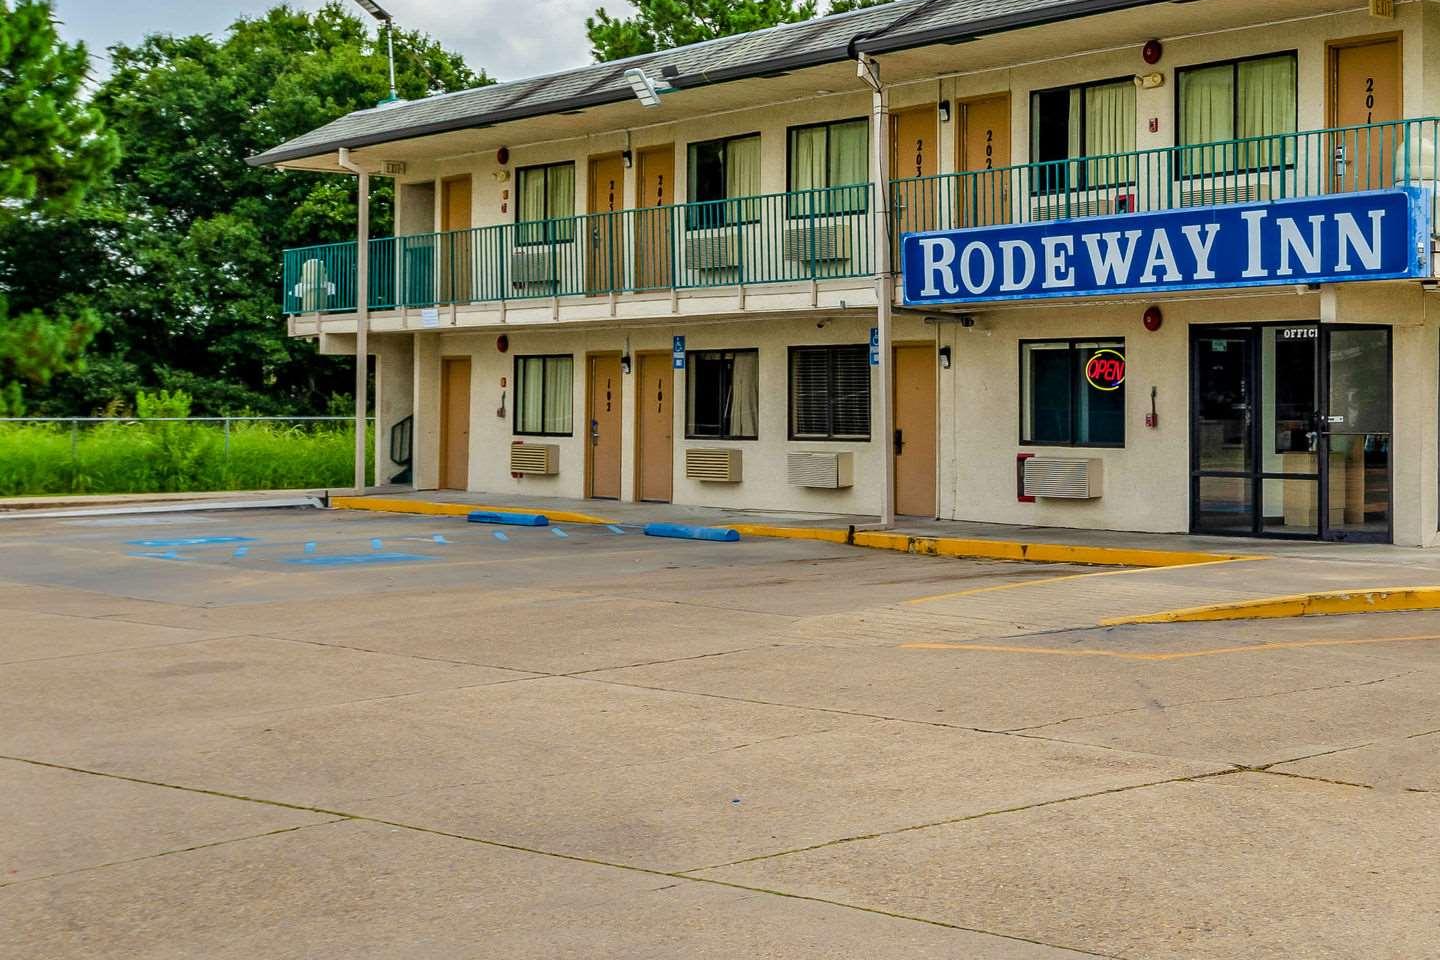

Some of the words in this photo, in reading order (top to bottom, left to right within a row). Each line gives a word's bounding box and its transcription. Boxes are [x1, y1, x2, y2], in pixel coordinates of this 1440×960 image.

[1365, 77, 1375, 124] 201
[915, 139, 924, 177] 203
[984, 129, 994, 169] 202
[919, 223, 1220, 297] RODEWAY
[1241, 209, 1386, 278] INN
[1088, 359, 1125, 381] OPEN
